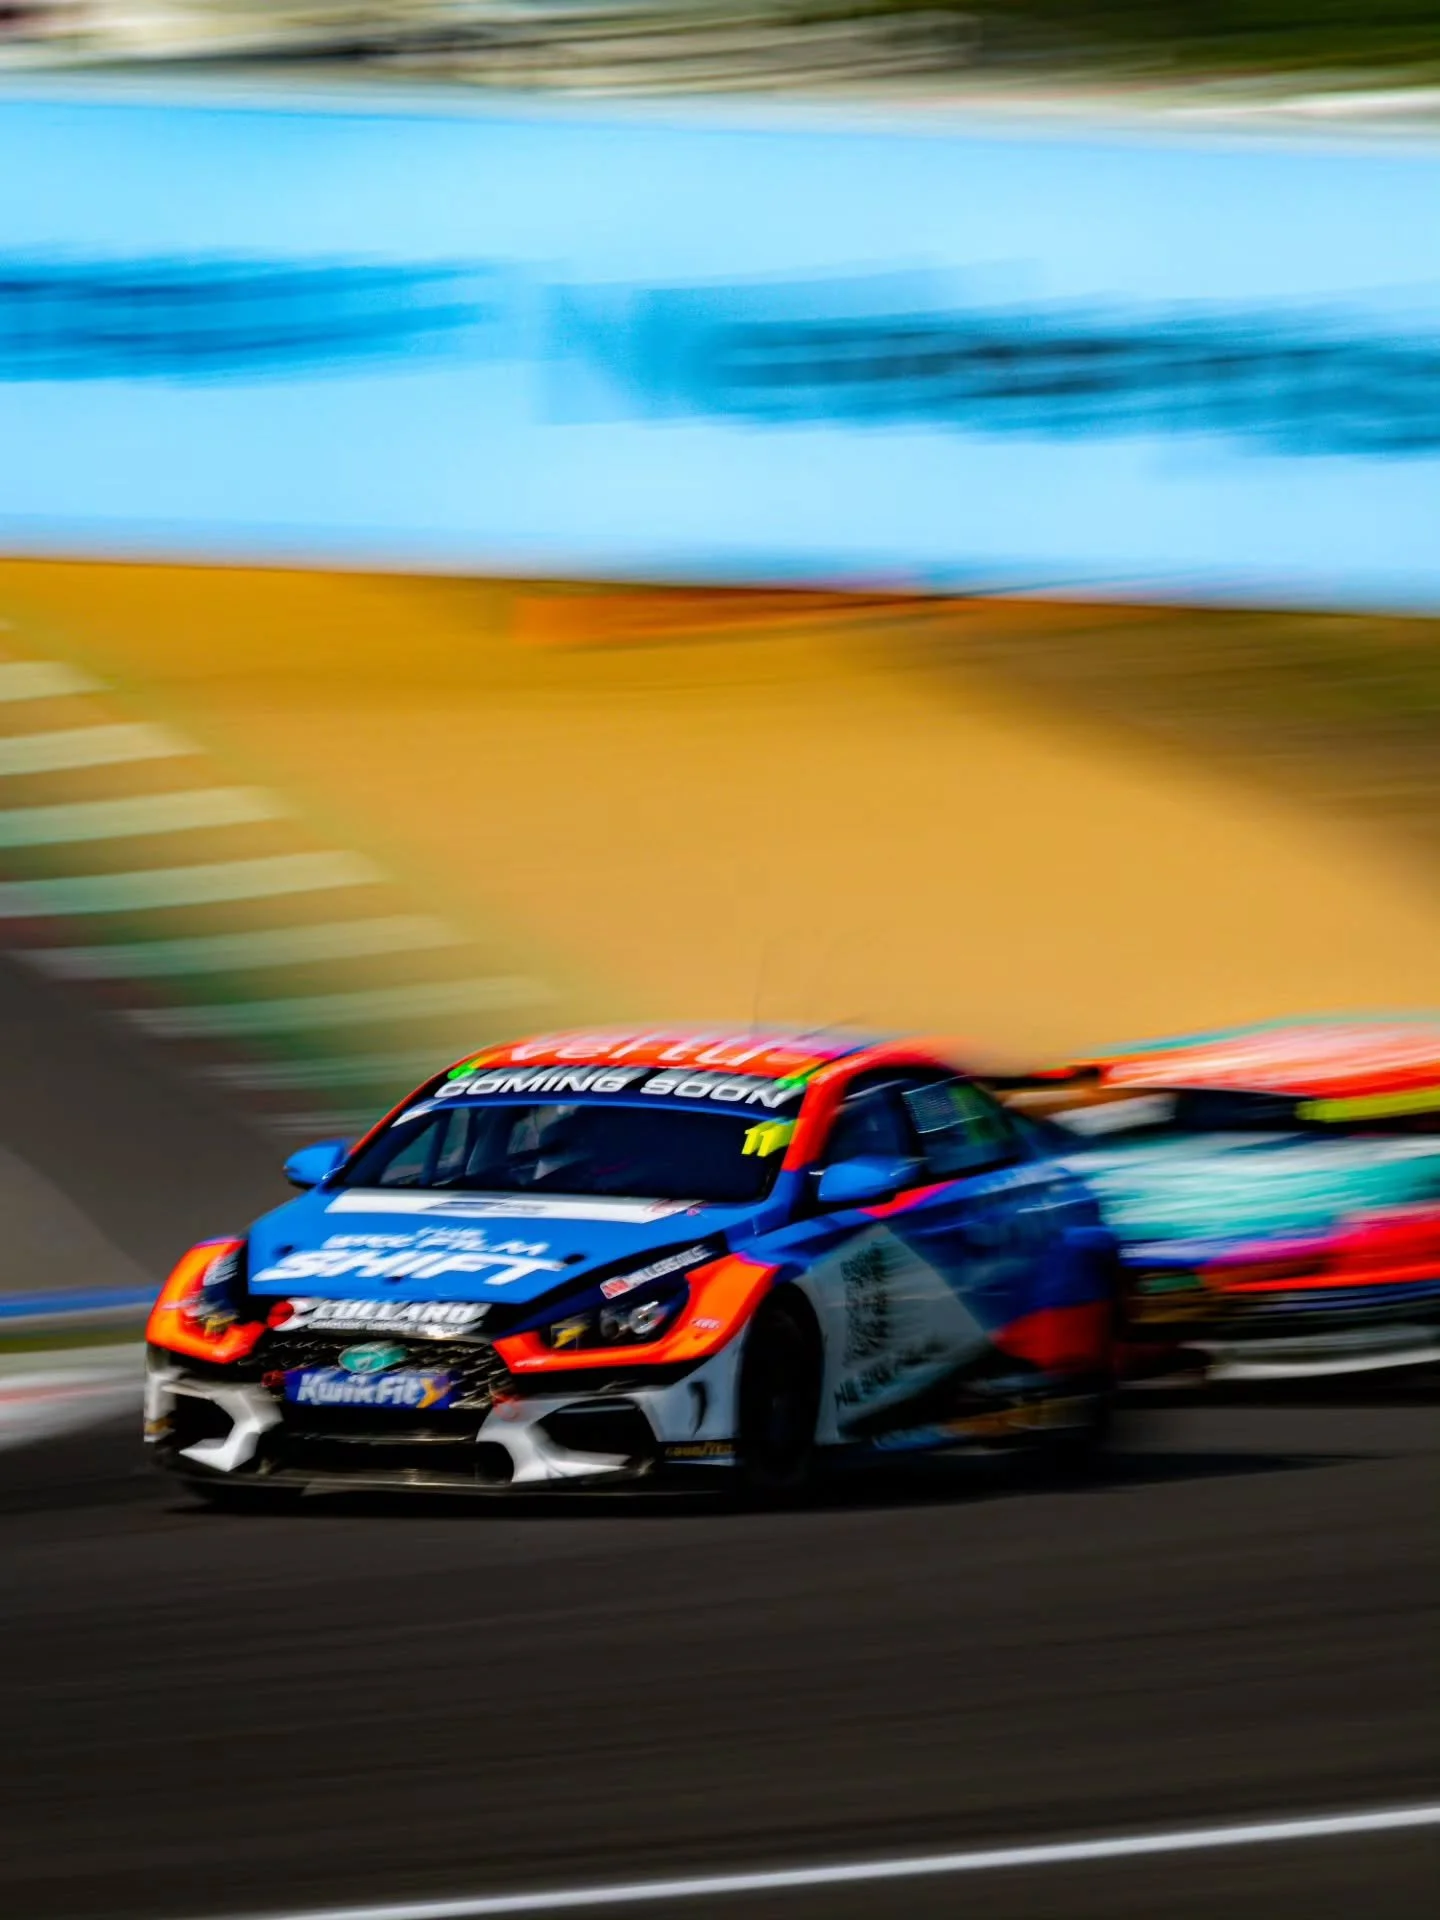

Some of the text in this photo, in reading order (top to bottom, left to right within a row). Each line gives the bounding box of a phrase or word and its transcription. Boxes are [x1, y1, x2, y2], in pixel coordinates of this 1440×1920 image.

[434, 1070, 793, 1109] COMING SOON
[741, 1122, 788, 1157] 11
[252, 1249, 566, 1285] SHIFT
